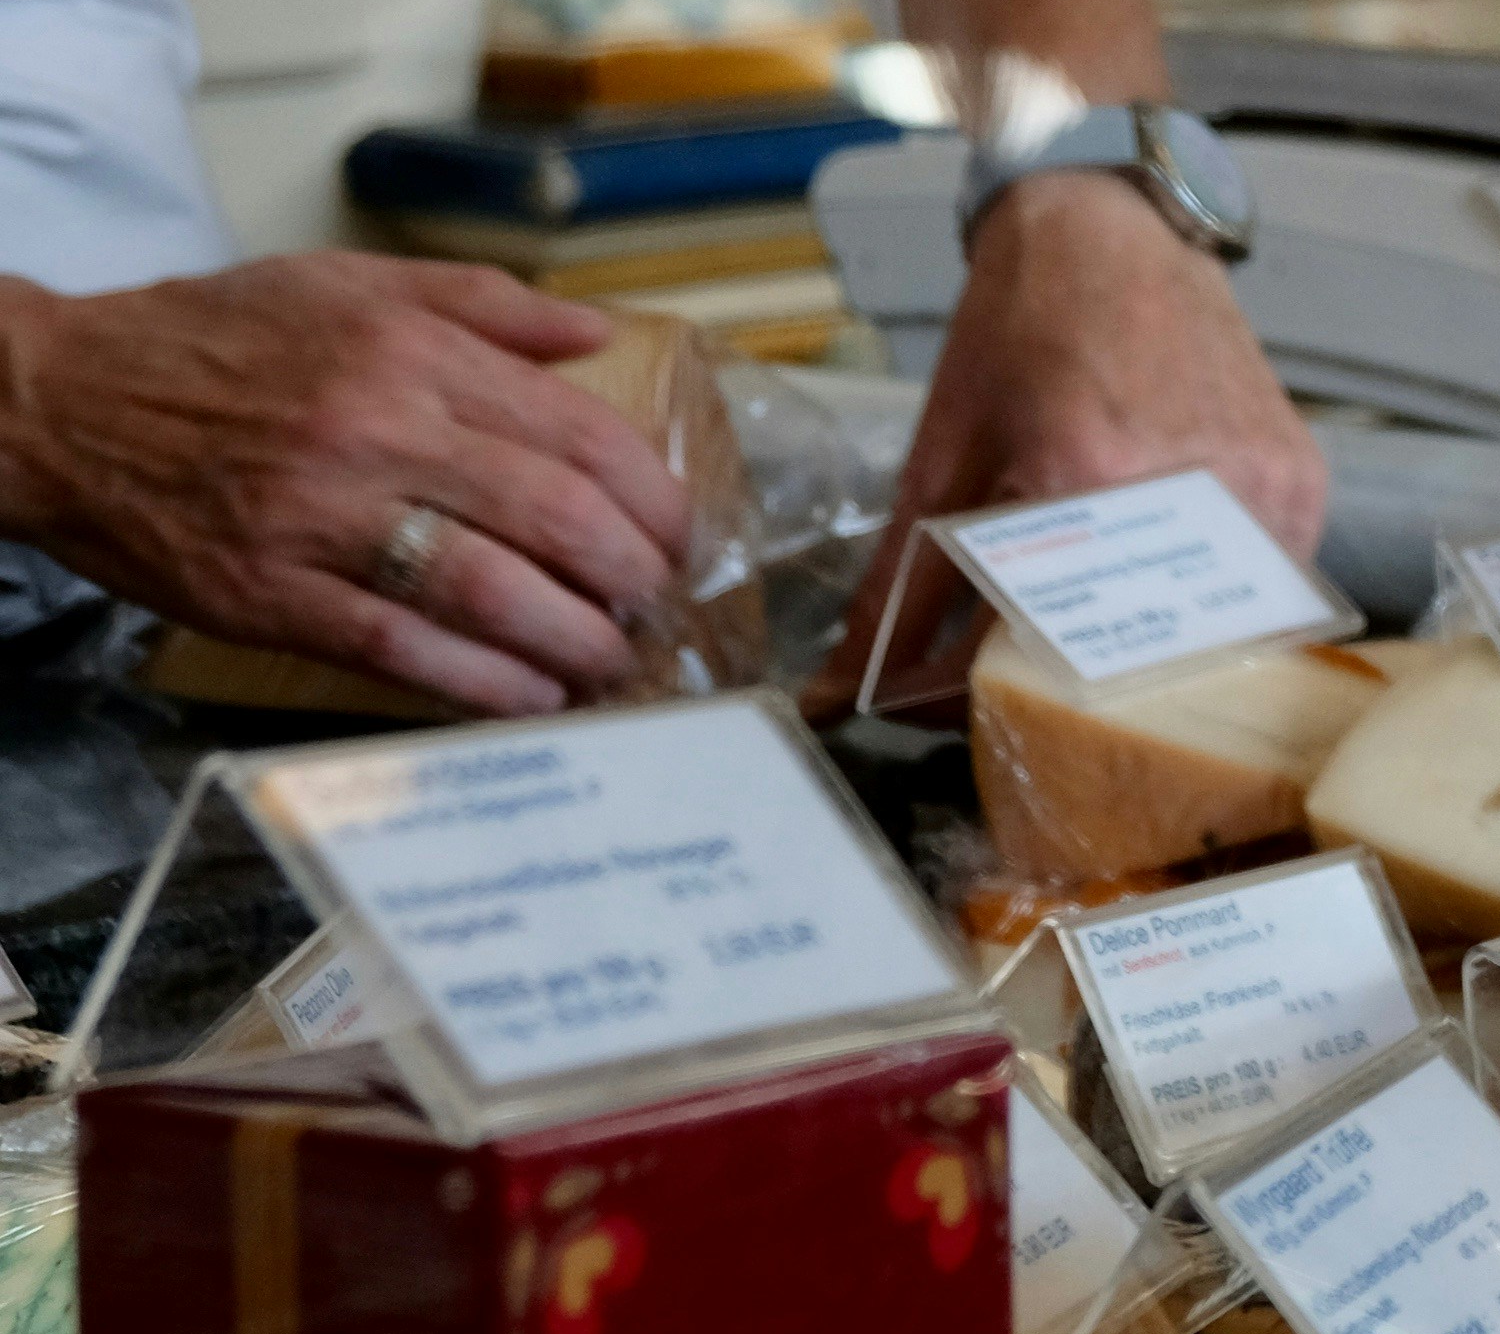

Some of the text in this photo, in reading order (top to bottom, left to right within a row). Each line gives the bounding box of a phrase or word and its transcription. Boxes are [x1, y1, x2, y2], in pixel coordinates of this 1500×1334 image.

[1088, 898, 1243, 955] Delice Pommard
[325, 967, 355, 997] Olive
[1150, 1075, 1201, 1104] PREIS
[1204, 1070, 1232, 1092] pro
[1234, 1057, 1262, 1082] 100
[1332, 1028, 1371, 1056] EUR
